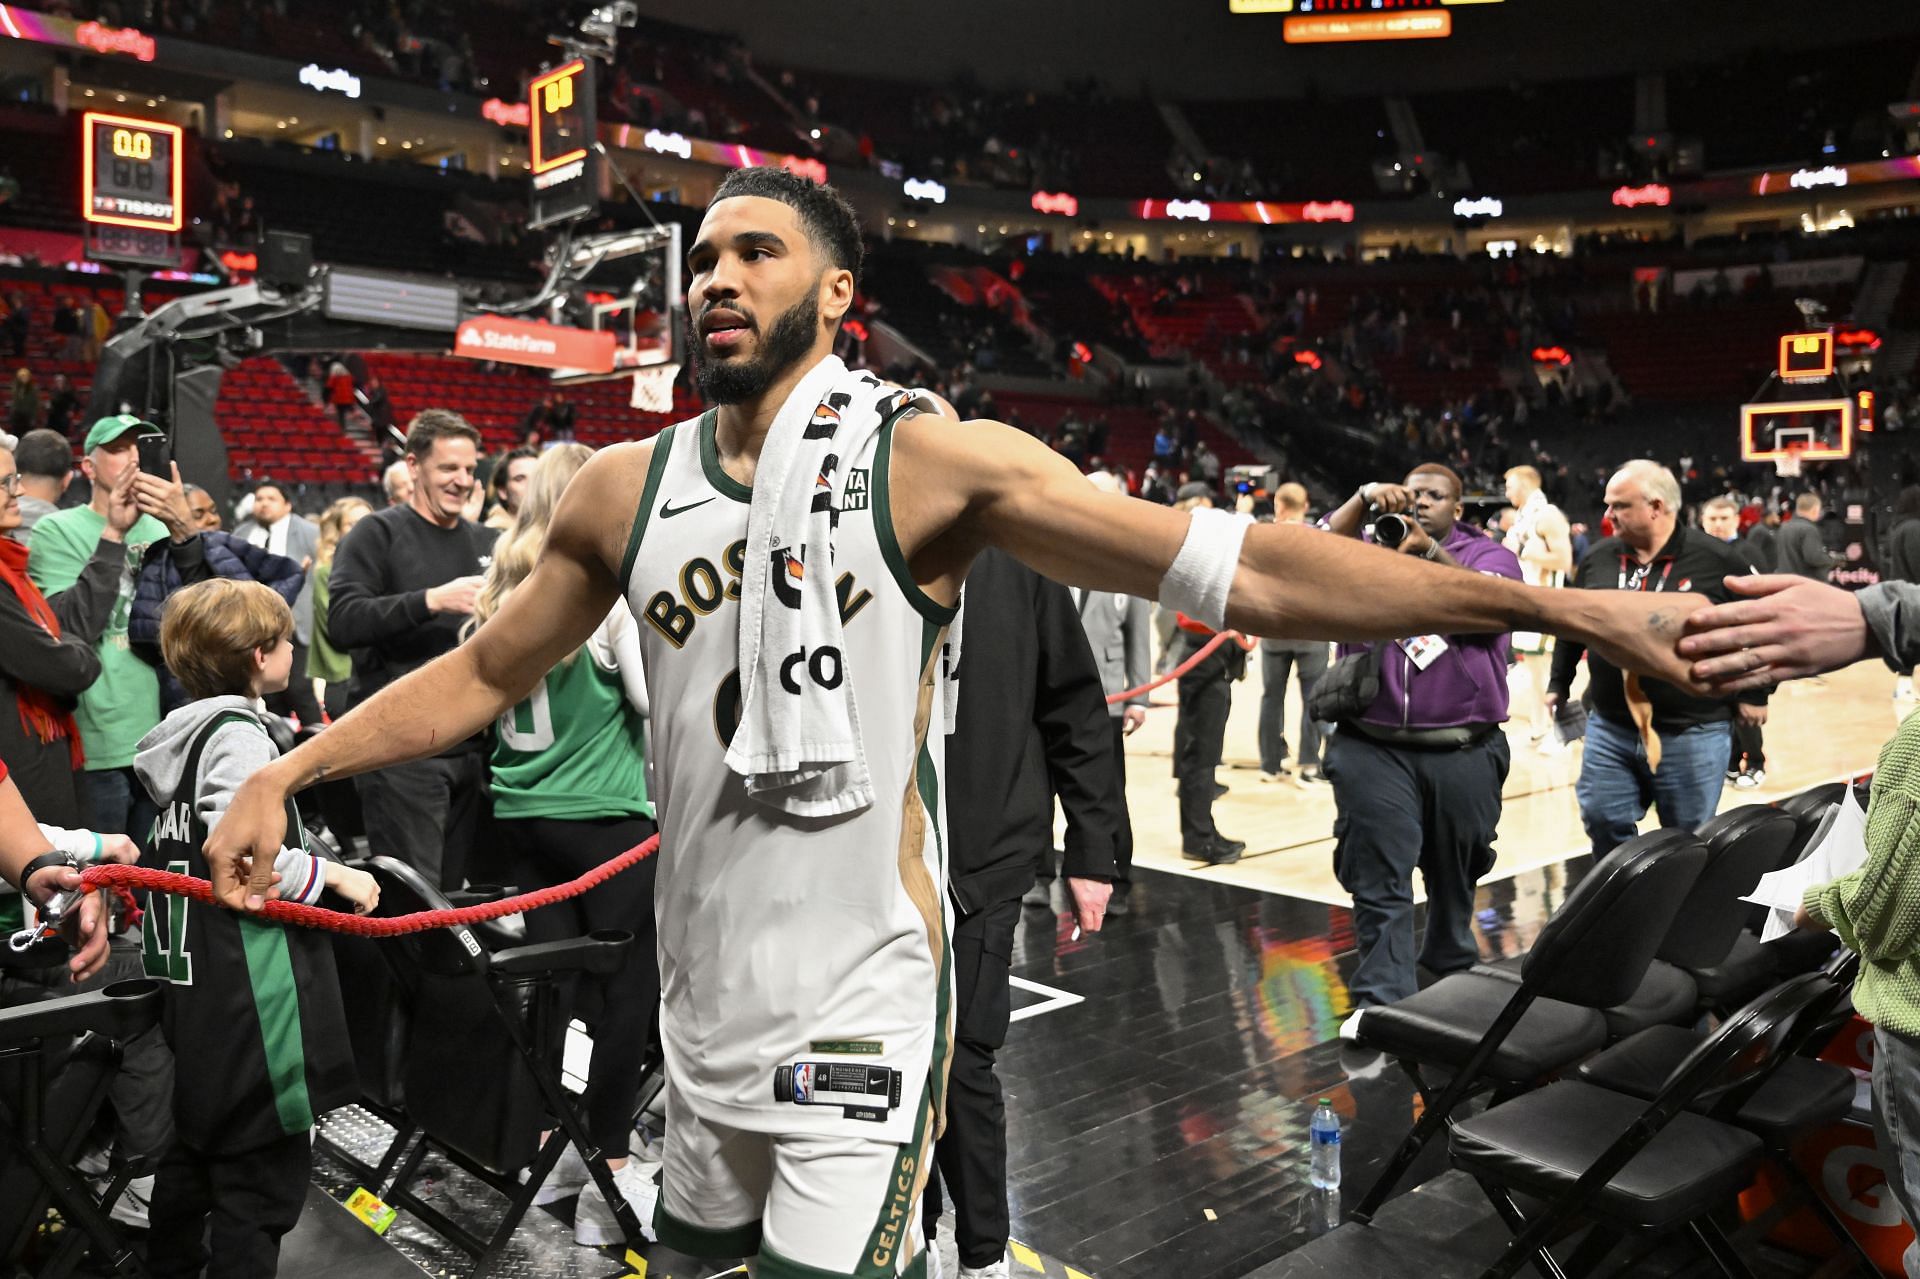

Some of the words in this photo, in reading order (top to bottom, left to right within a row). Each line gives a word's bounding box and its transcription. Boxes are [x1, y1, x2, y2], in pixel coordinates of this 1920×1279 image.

[117, 199, 174, 218] TISSOT
[643, 538, 874, 650] BOSN
[872, 1156, 914, 1267] CELTICS
